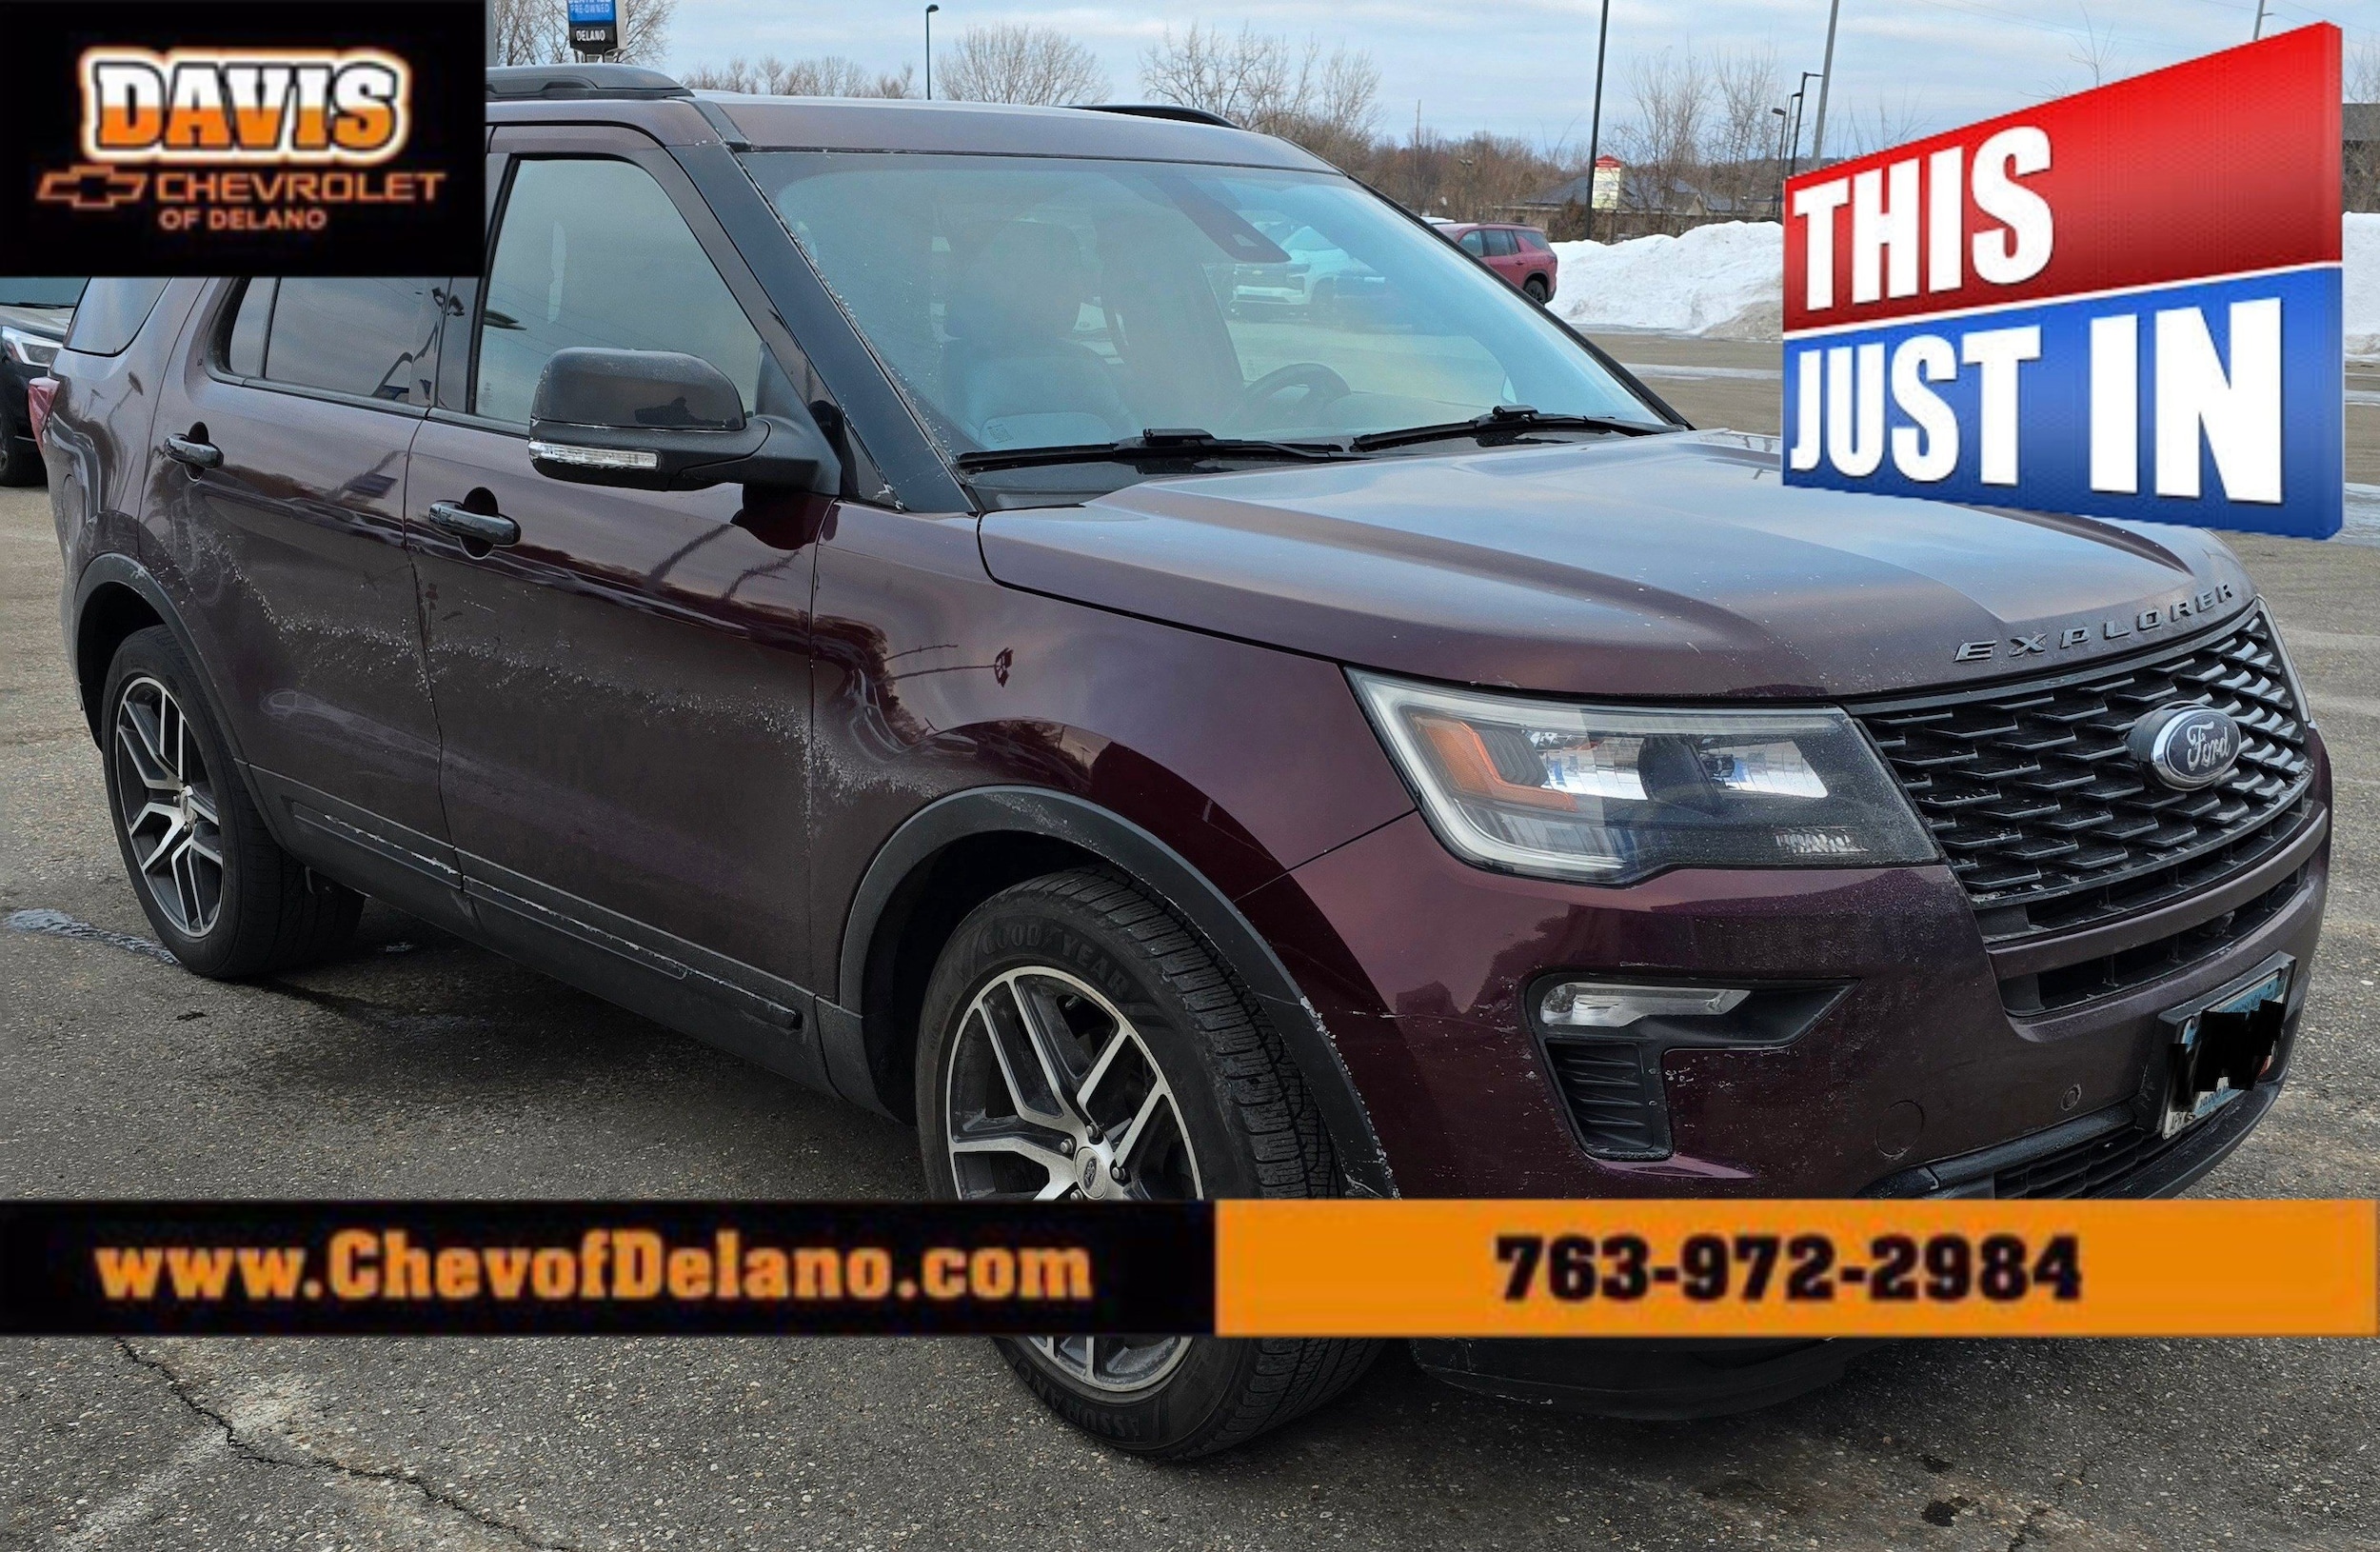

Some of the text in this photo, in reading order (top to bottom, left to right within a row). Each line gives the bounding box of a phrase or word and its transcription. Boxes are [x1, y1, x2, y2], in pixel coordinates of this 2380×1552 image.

[576, 30, 605, 41] DELANO
[1954, 583, 2233, 663] EXPLORER
[2187, 721, 2231, 771] Ford
